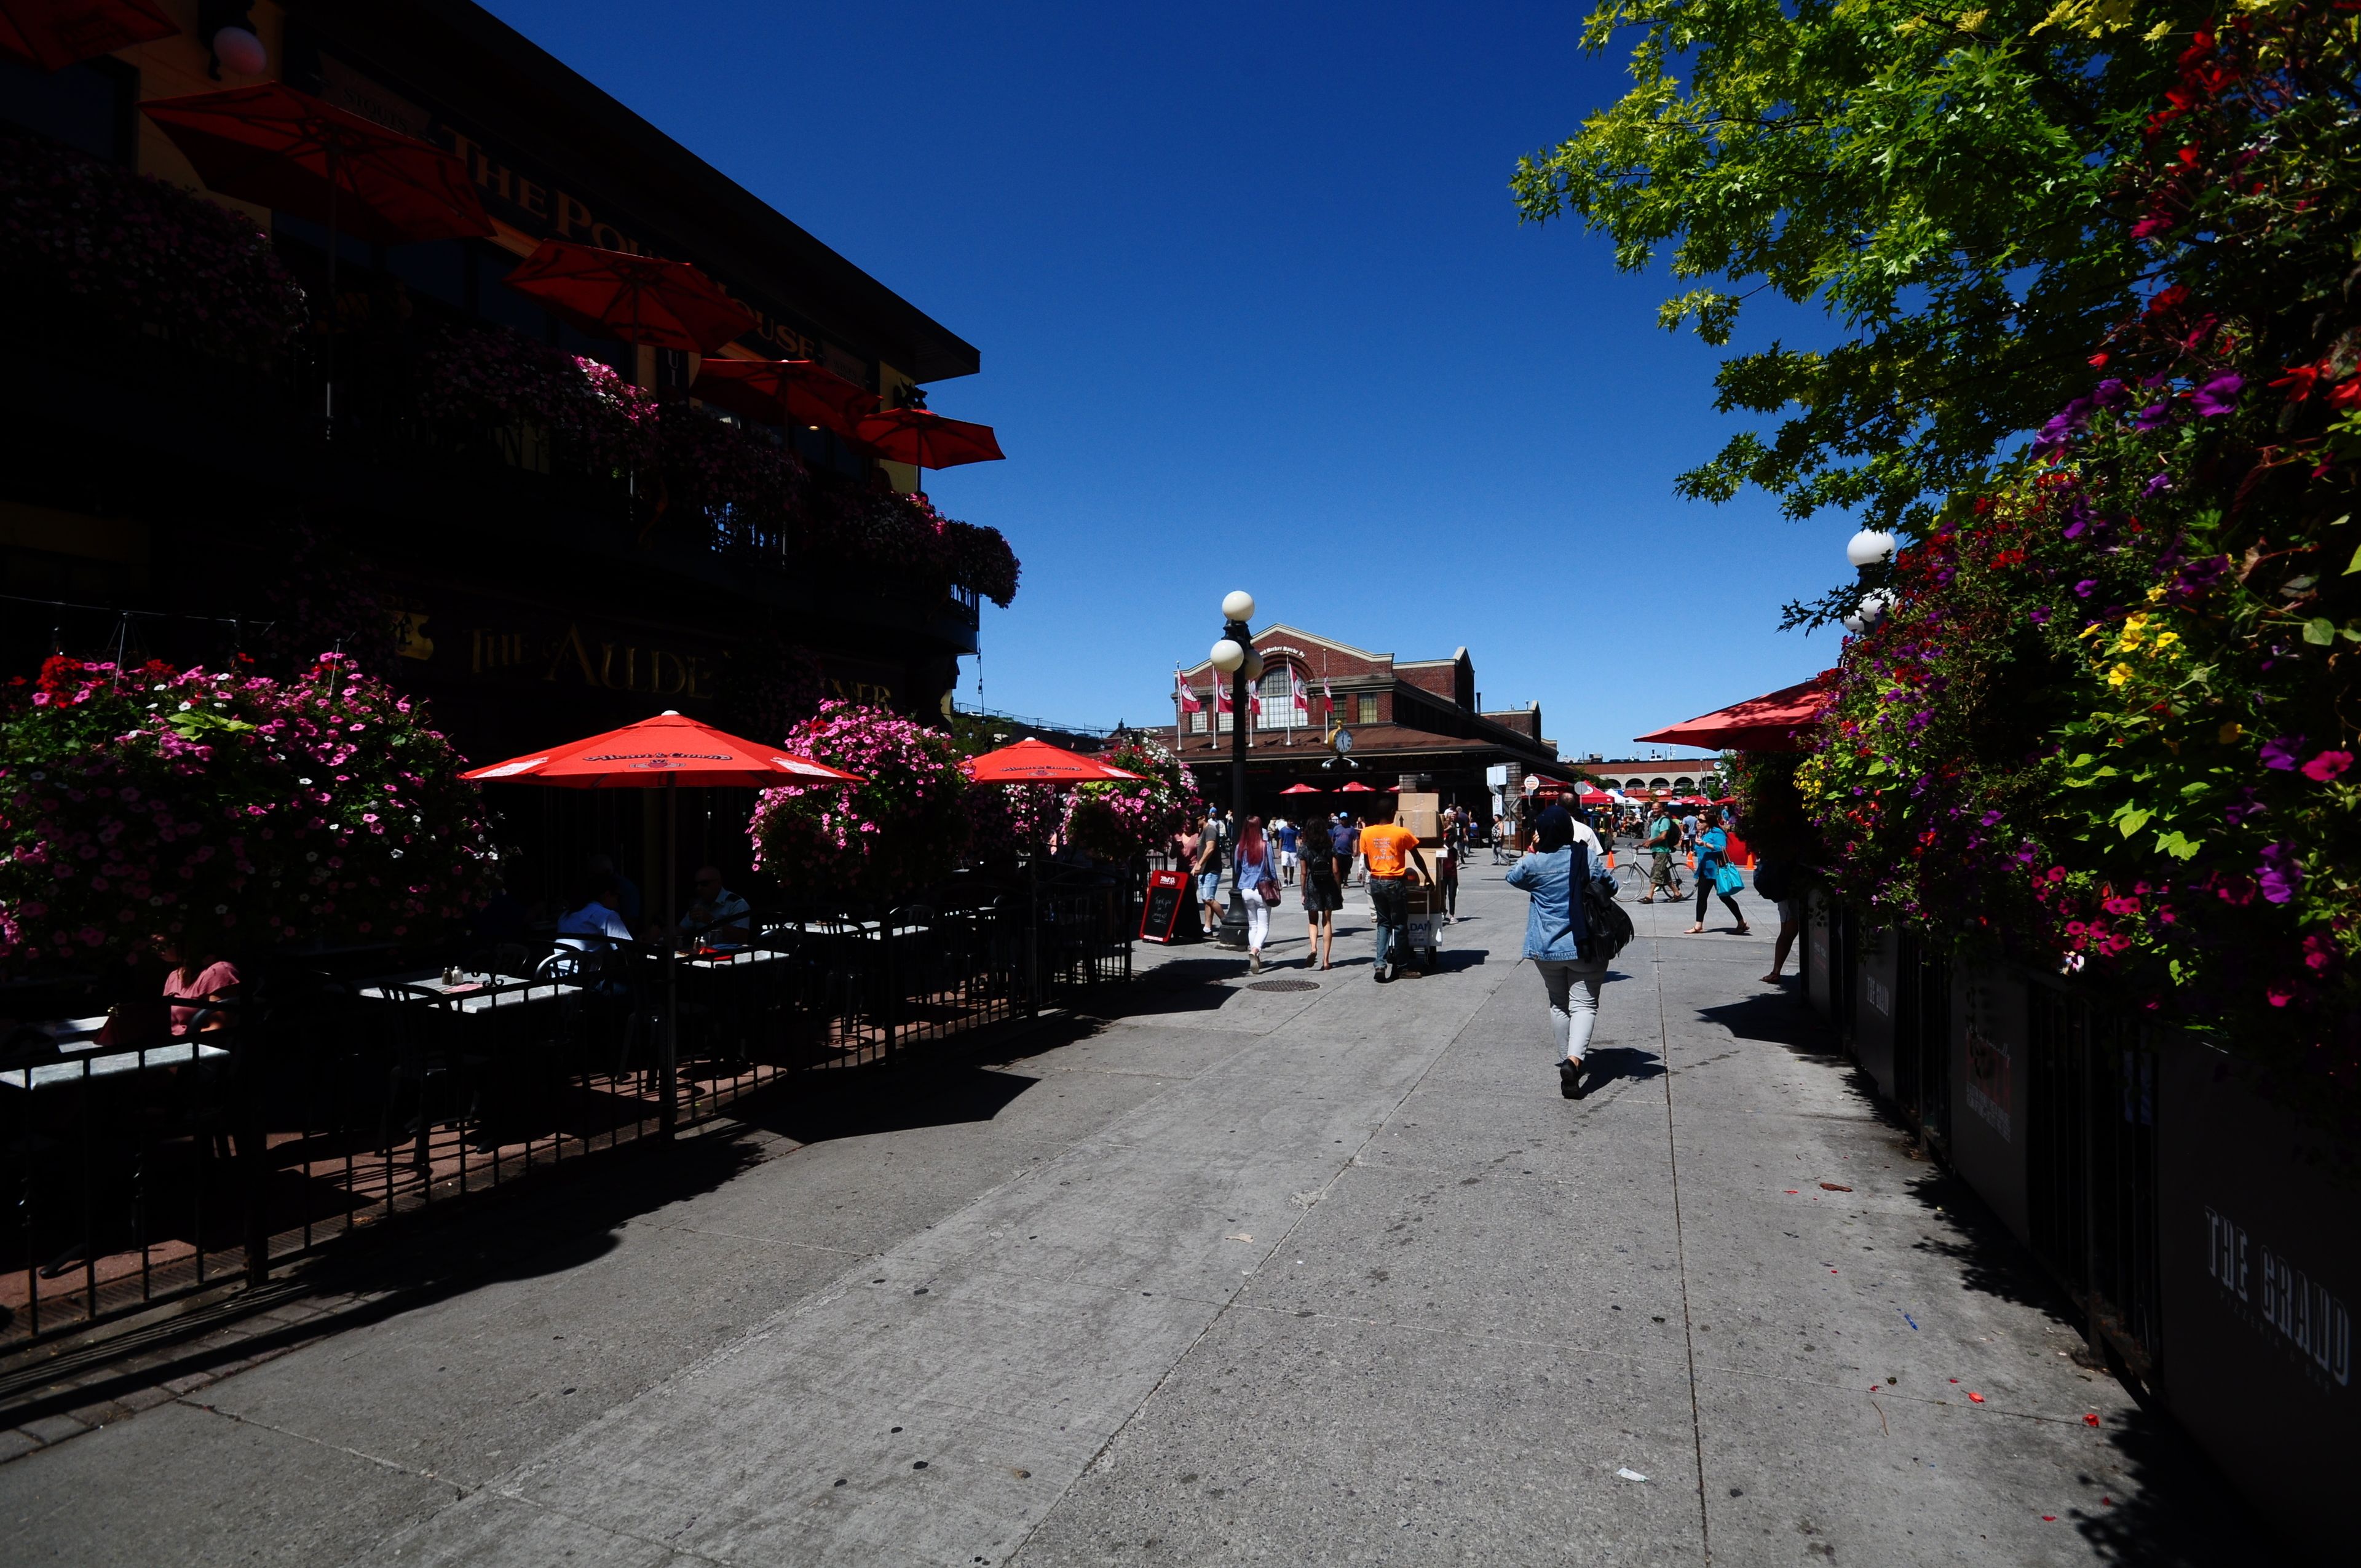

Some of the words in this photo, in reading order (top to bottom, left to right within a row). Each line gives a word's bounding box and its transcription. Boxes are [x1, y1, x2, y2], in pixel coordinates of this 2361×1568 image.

[440, 122, 548, 220] THE
[1410, 921, 1431, 931] DAN
[2204, 1205, 2248, 1303] THE
[2260, 1244, 2351, 1387] GRAND
[2219, 1290, 2280, 1349] PIZZERIA
